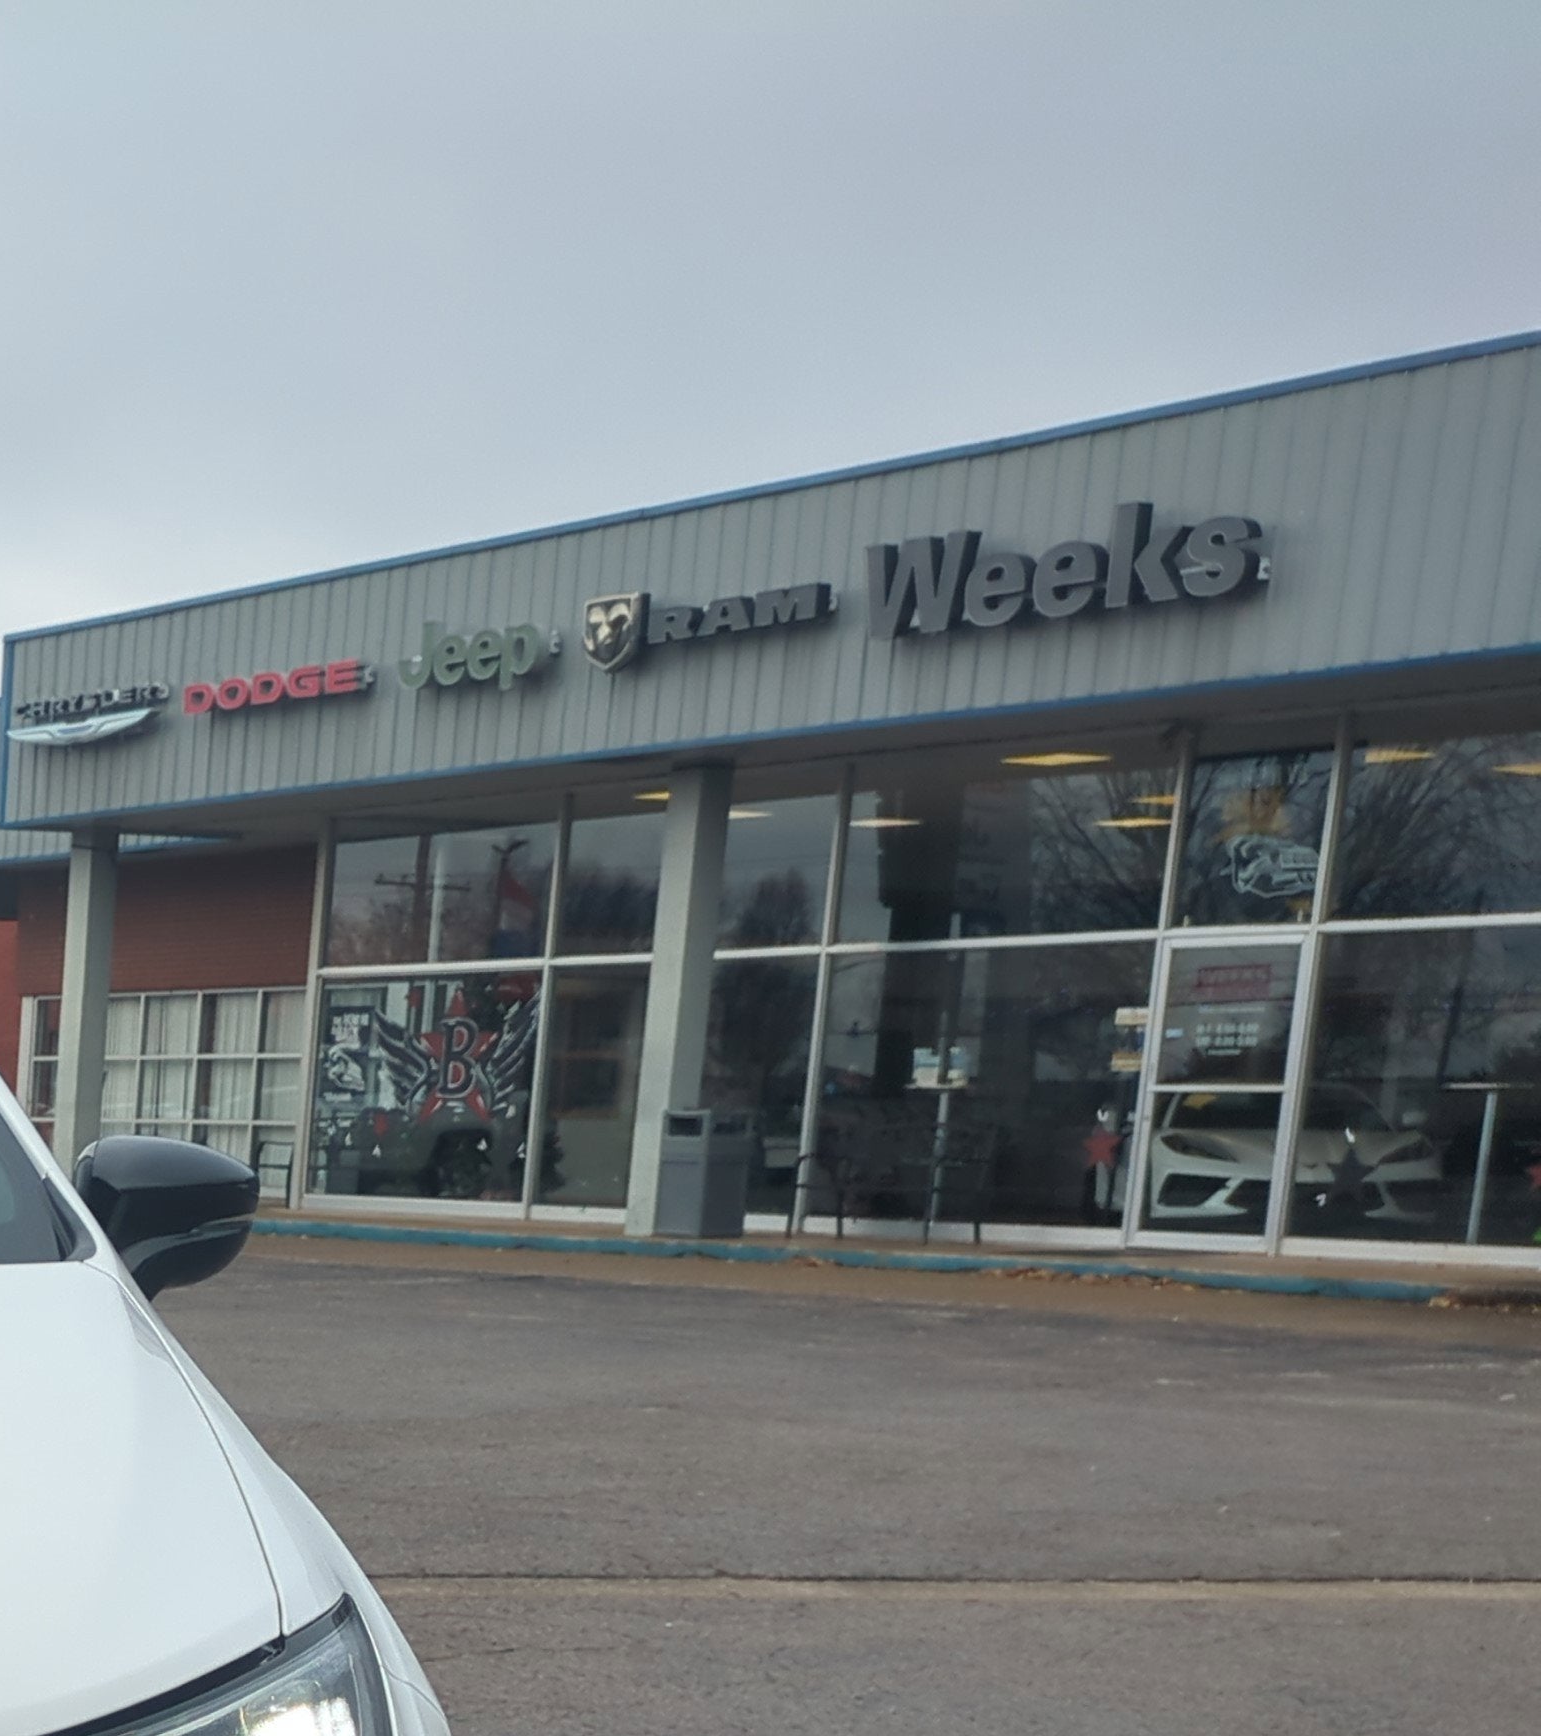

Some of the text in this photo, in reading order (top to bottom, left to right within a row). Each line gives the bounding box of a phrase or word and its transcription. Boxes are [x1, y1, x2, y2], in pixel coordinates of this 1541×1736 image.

[865, 502, 1263, 640] Weeks
[647, 583, 831, 644] RAM
[183, 658, 362, 714] DODGE
[398, 620, 541, 691] Jeep
